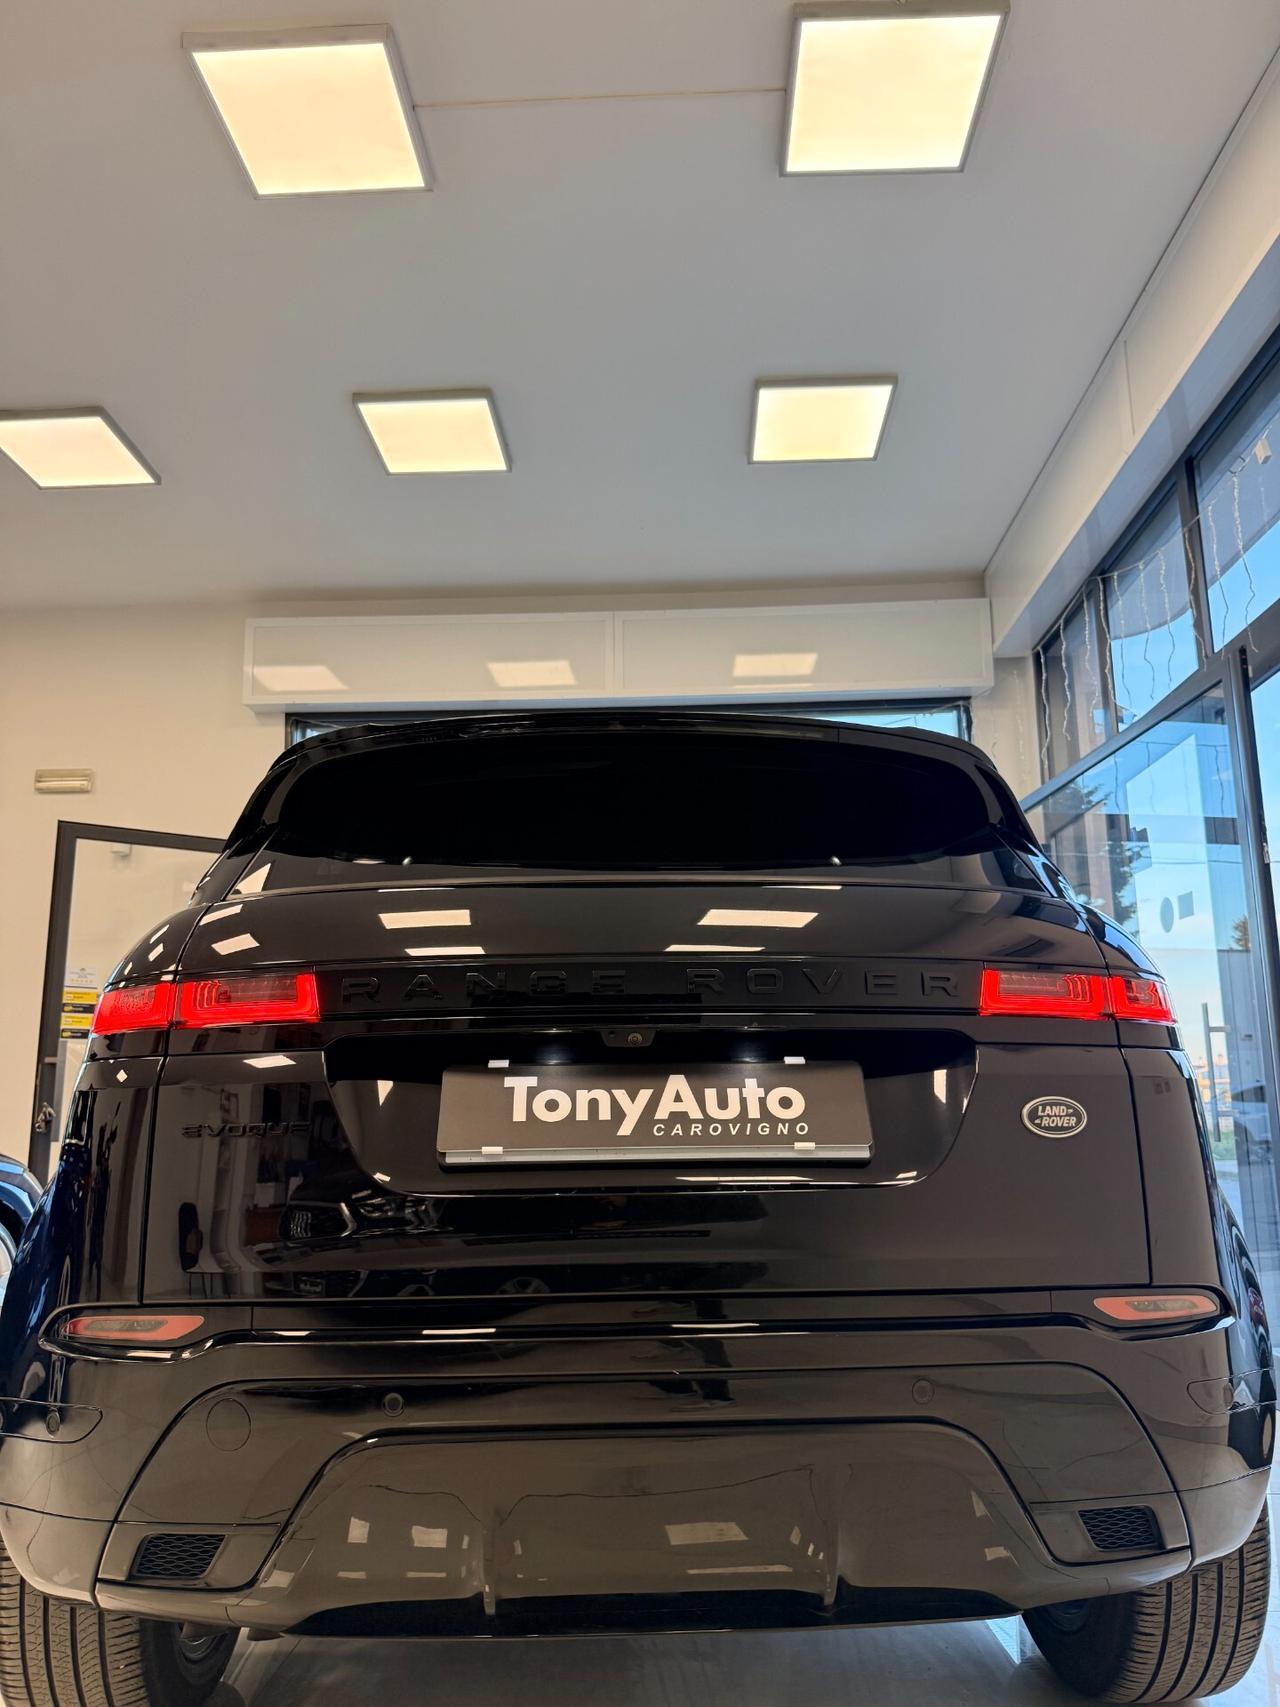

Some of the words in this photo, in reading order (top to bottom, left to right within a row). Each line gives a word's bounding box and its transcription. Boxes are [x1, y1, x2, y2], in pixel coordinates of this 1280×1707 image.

[341, 970, 627, 1002] RANGE
[686, 968, 958, 998] ROVER
[504, 1074, 806, 1136] TonyAuto
[1037, 1105, 1067, 1116] LAND
[653, 1122, 809, 1136] CAROVIGNO
[1041, 1116, 1077, 1127] ROVER
[181, 1121, 312, 1138] EVOQUE
